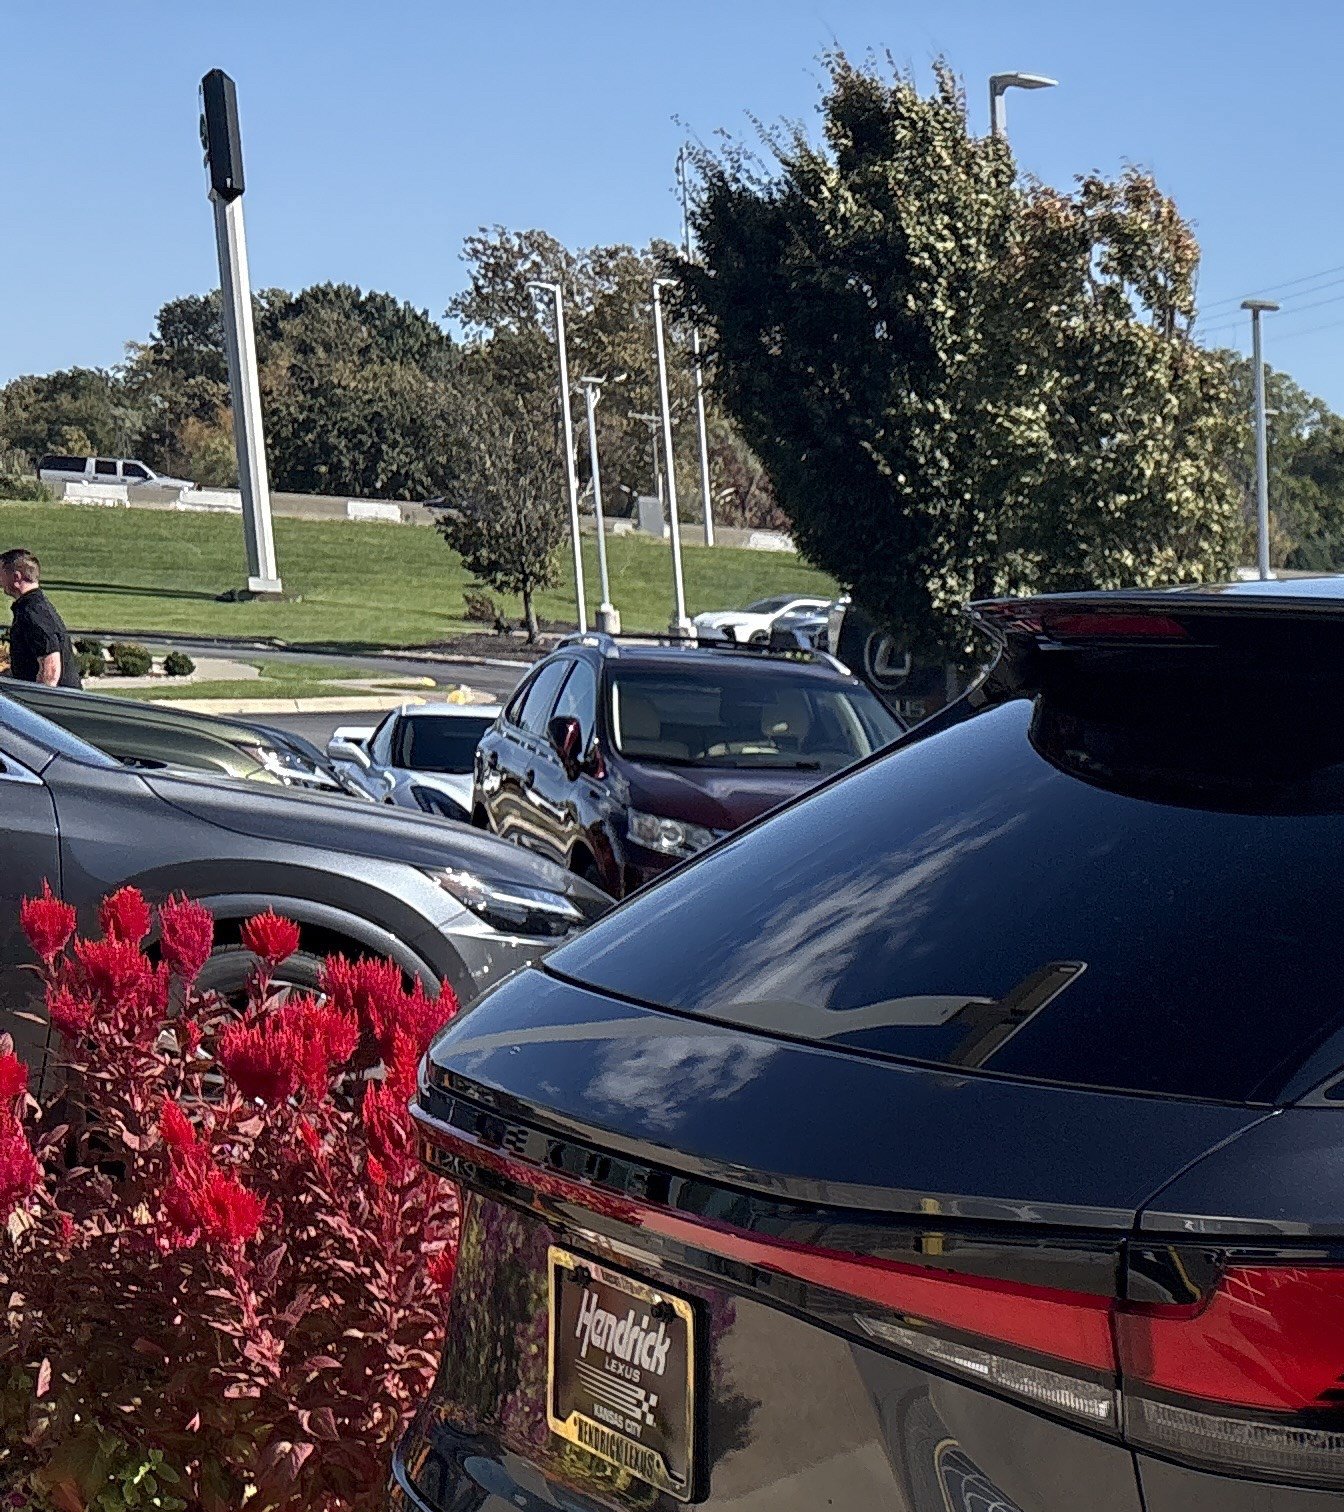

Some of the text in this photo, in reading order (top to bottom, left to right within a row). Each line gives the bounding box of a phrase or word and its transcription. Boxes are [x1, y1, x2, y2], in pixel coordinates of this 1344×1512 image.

[575, 1287, 671, 1376] Hendrick
[604, 1356, 643, 1384] LEXUS
[593, 1403, 643, 1439] KANSAS CITY
[624, 1441, 656, 1479] LEXUS
